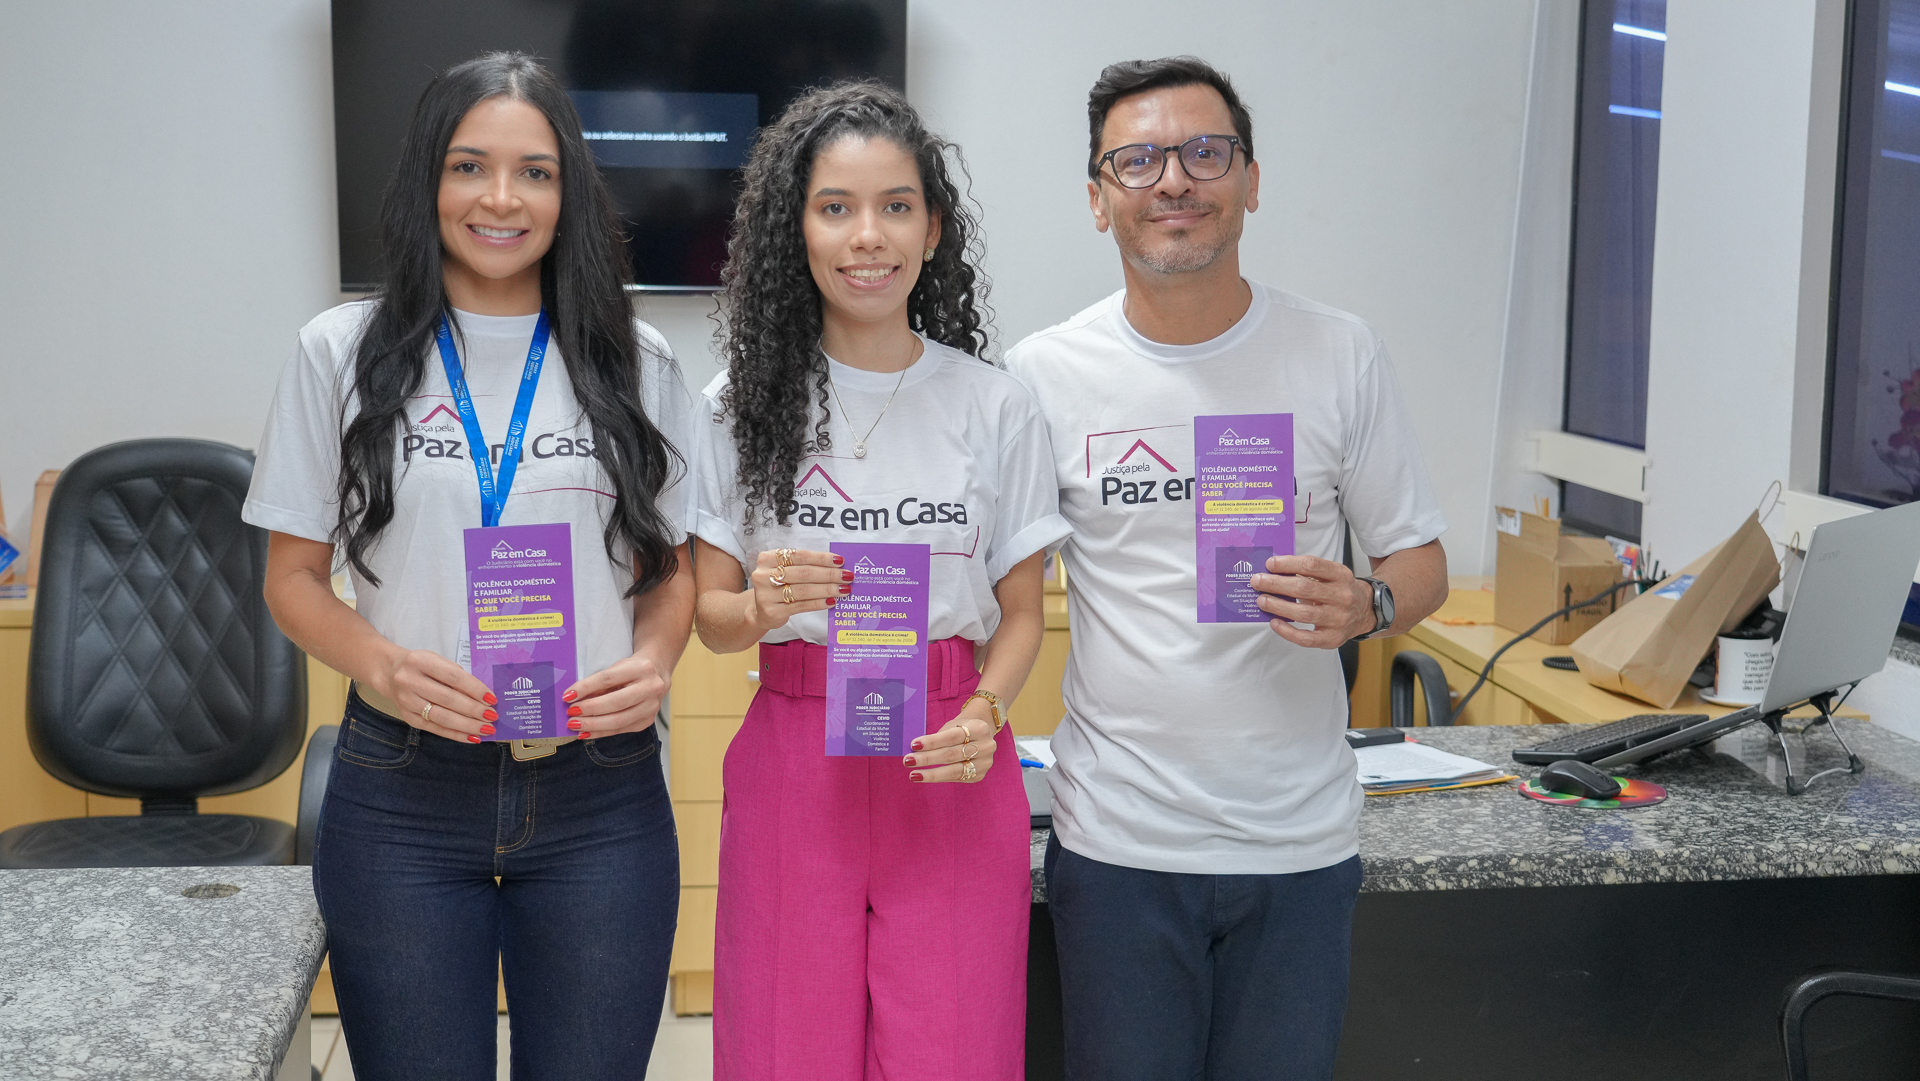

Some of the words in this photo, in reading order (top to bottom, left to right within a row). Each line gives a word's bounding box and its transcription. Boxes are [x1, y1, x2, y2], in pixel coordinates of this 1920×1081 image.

[403, 424, 433, 434] Justiça
[435, 424, 454, 433] pela
[1219, 438, 1234, 446] Paz
[1250, 437, 1269, 445] Casa
[403, 434, 464, 462] Paz
[1102, 464, 1131, 475] Justiça
[1131, 463, 1150, 474] pela
[810, 487, 827, 497] pela
[1101, 477, 1158, 505] Paz
[840, 508, 890, 531] em
[896, 498, 967, 526] Casa
[491, 550, 508, 559] Paz
[525, 548, 547, 557] Casa
[854, 565, 869, 574] Paz
[885, 566, 906, 575] Casa
[473, 580, 512, 588] VIOLÊNCIA
[499, 595, 520, 603] VOCÊ
